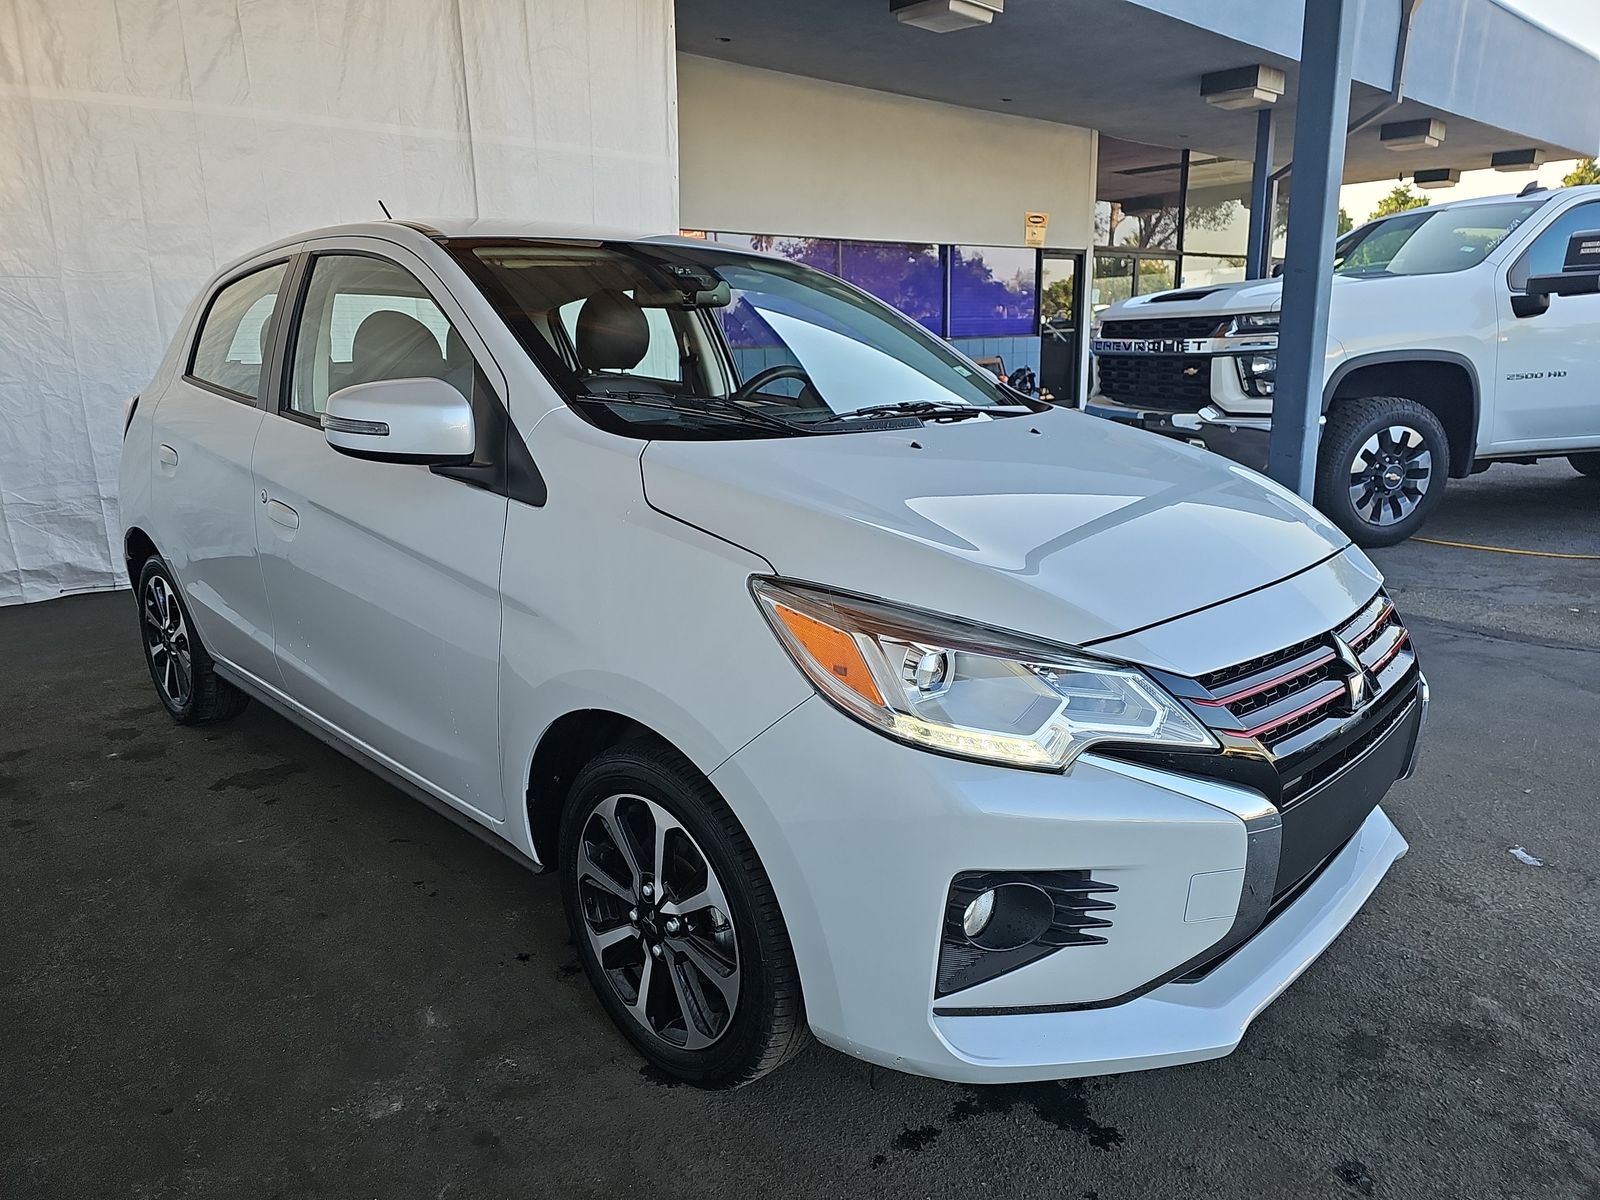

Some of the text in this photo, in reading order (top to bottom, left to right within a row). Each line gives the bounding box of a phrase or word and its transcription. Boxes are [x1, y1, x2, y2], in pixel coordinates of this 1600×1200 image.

[1095, 339, 1208, 353] CHEVROLET
[1506, 370, 1567, 381] 2500 HD
